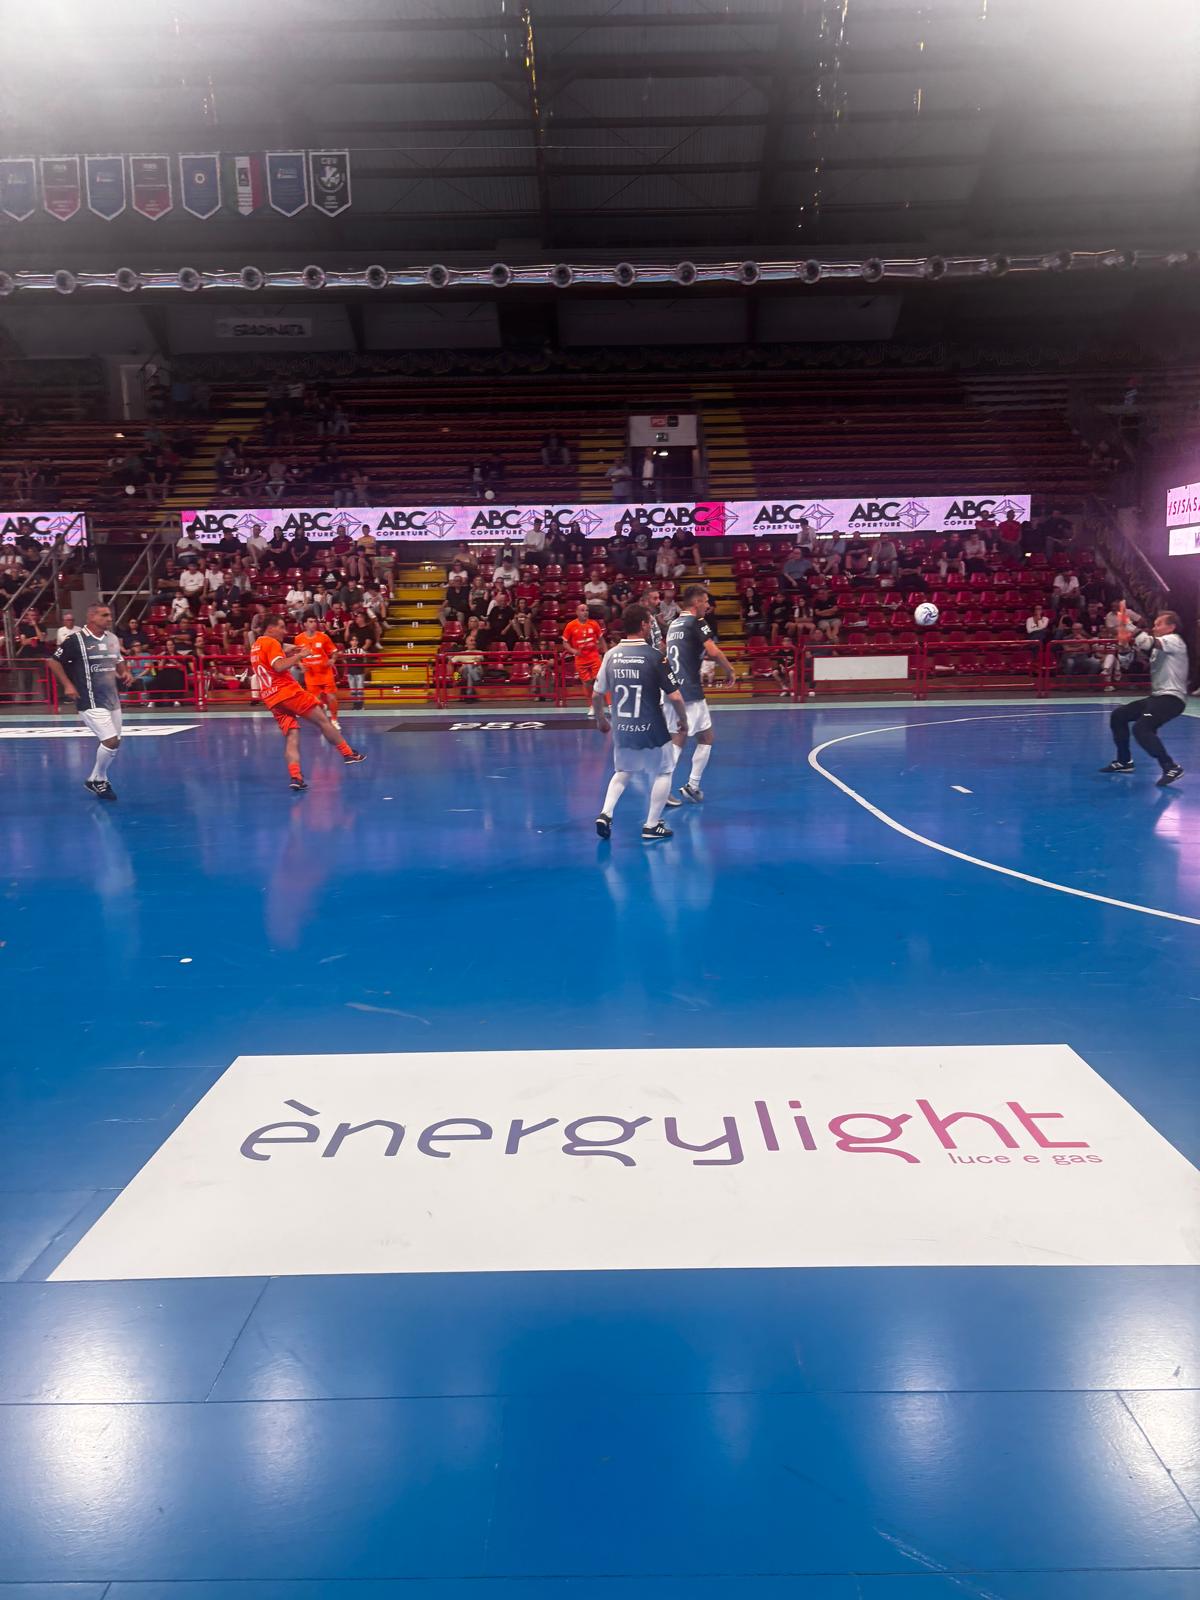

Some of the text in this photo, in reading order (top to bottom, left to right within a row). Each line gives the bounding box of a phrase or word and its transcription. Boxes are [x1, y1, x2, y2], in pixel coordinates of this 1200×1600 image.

[470, 509, 522, 529] ABC
[753, 504, 806, 525] ABC
[848, 501, 901, 522] ABC
[944, 499, 997, 520] ABC
[1, 516, 52, 535] ABC
[190, 513, 239, 533] ABC
[282, 512, 333, 531] ABC
[376, 510, 428, 530] ABC
[753, 523, 801, 531] COPERTUR
[613, 668, 640, 680] TESTINI
[614, 684, 643, 719] 27
[239, 1098, 1091, 1167] ènergylight
[948, 1152, 1103, 1166] luce e gas
